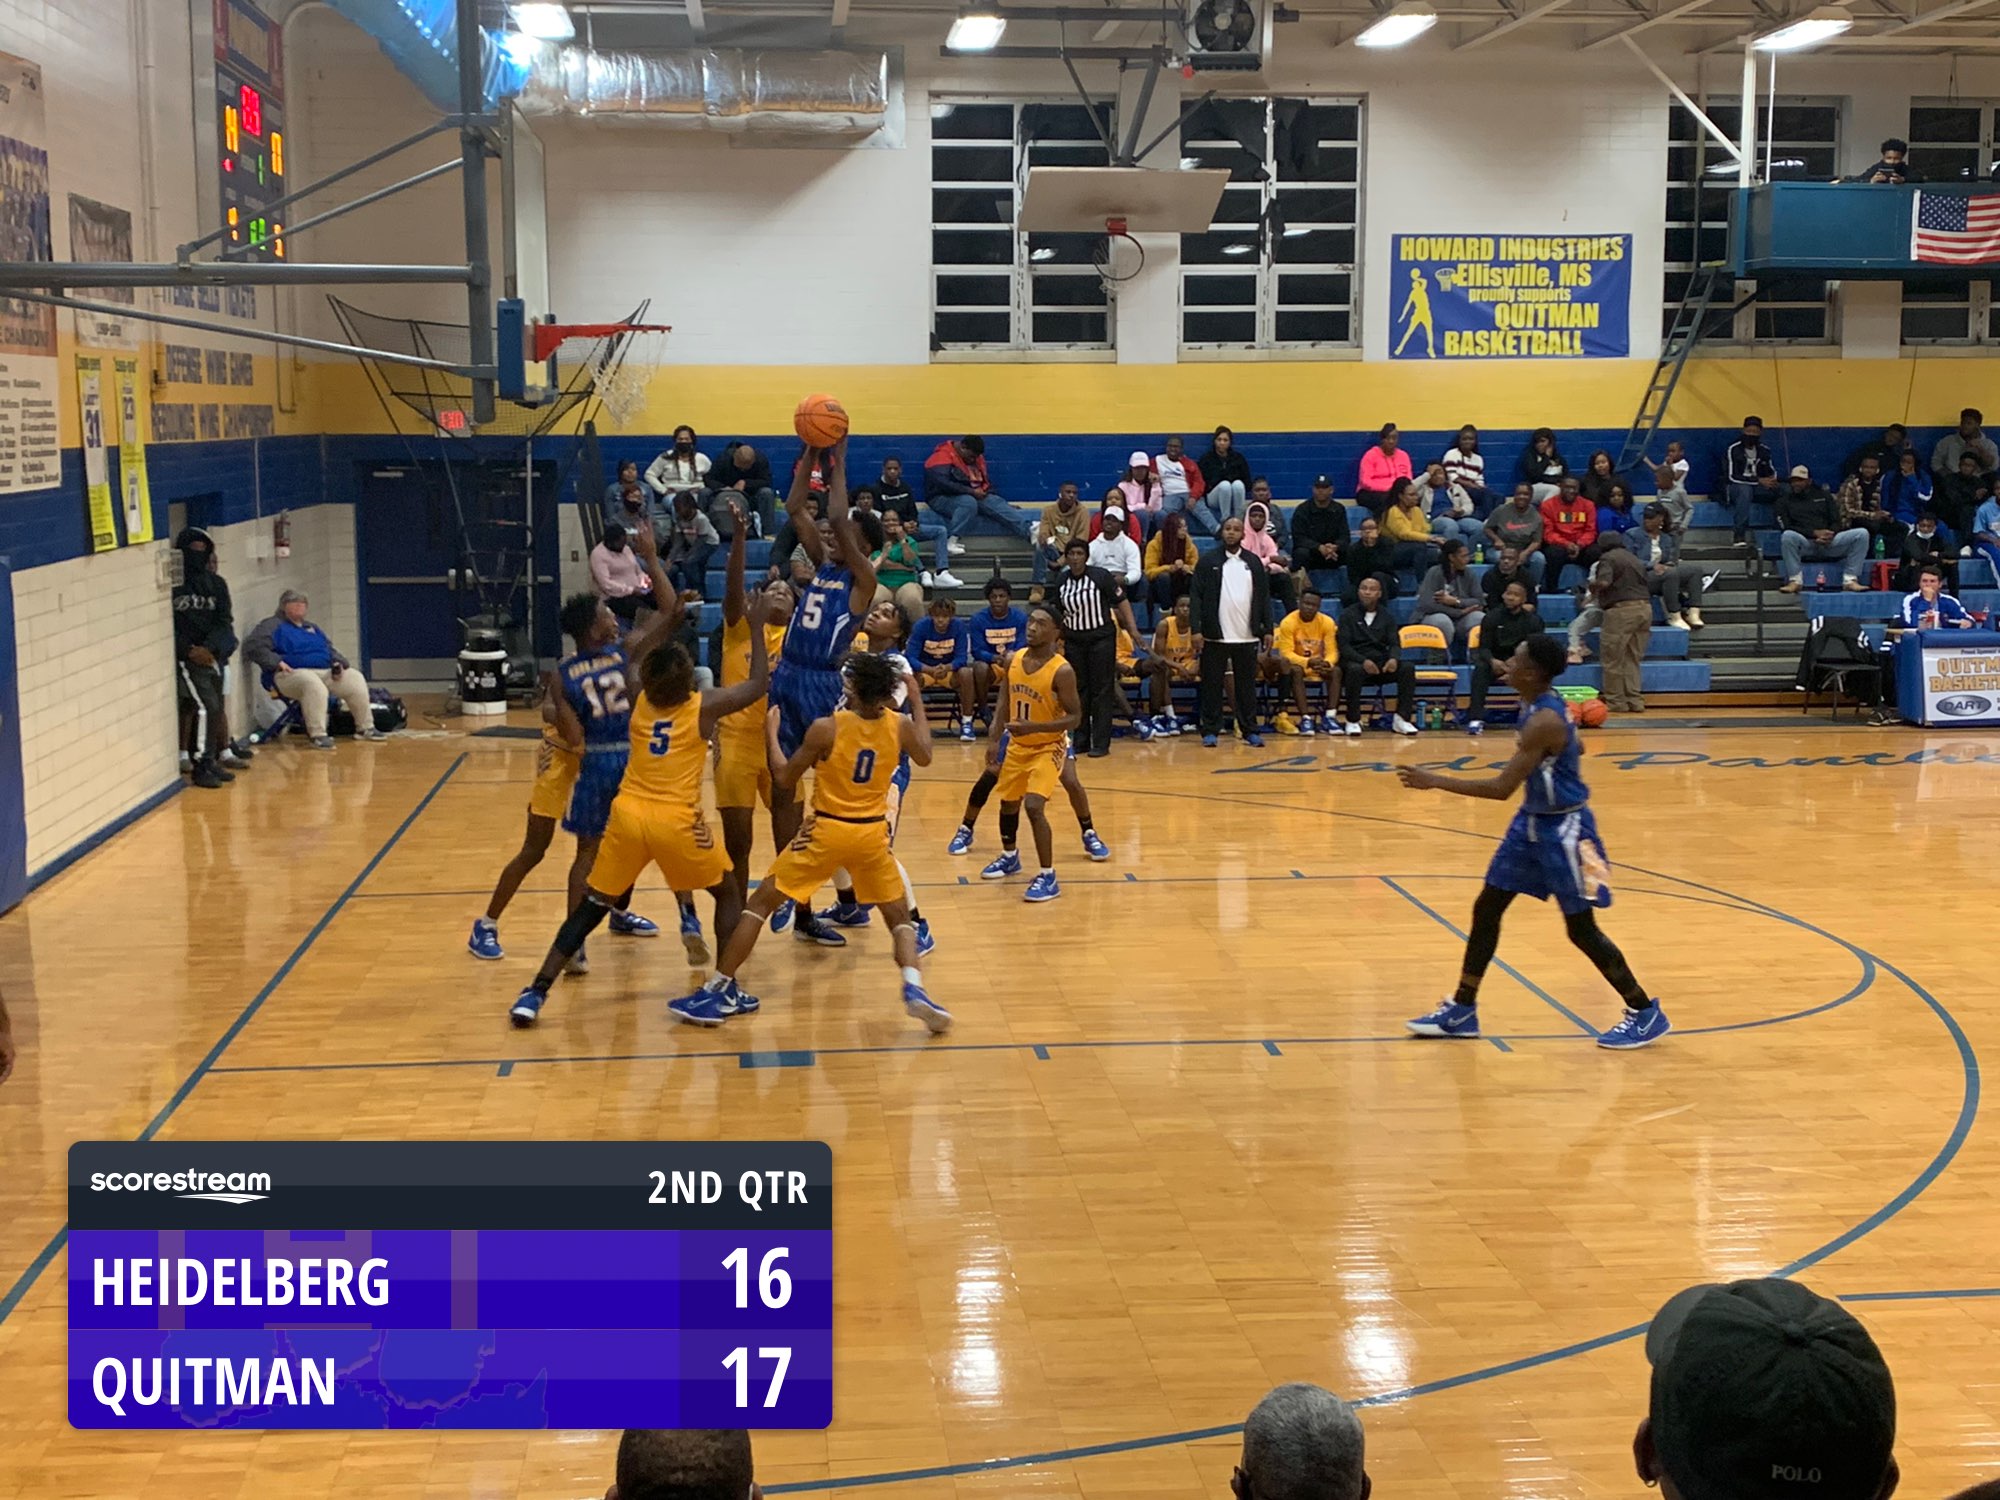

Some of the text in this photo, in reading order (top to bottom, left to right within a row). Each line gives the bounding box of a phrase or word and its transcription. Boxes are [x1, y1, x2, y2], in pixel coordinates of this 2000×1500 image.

[1401, 236, 1624, 261] HOWARD INDUSTRIES
[1457, 263, 1592, 288] Ellisville, MS
[1468, 286, 1571, 304] proudly supports
[1494, 302, 1599, 330] QUITMAN
[1444, 329, 1584, 356] BASKETBALL
[802, 592, 826, 629] 5
[581, 671, 630, 719] 12
[1929, 674, 2000, 693] BASKET
[1016, 699, 1030, 721] 11
[1943, 700, 1984, 711] DART
[648, 719, 673, 757] 5
[851, 748, 876, 784] 0
[1771, 1463, 1822, 1483] POLO
